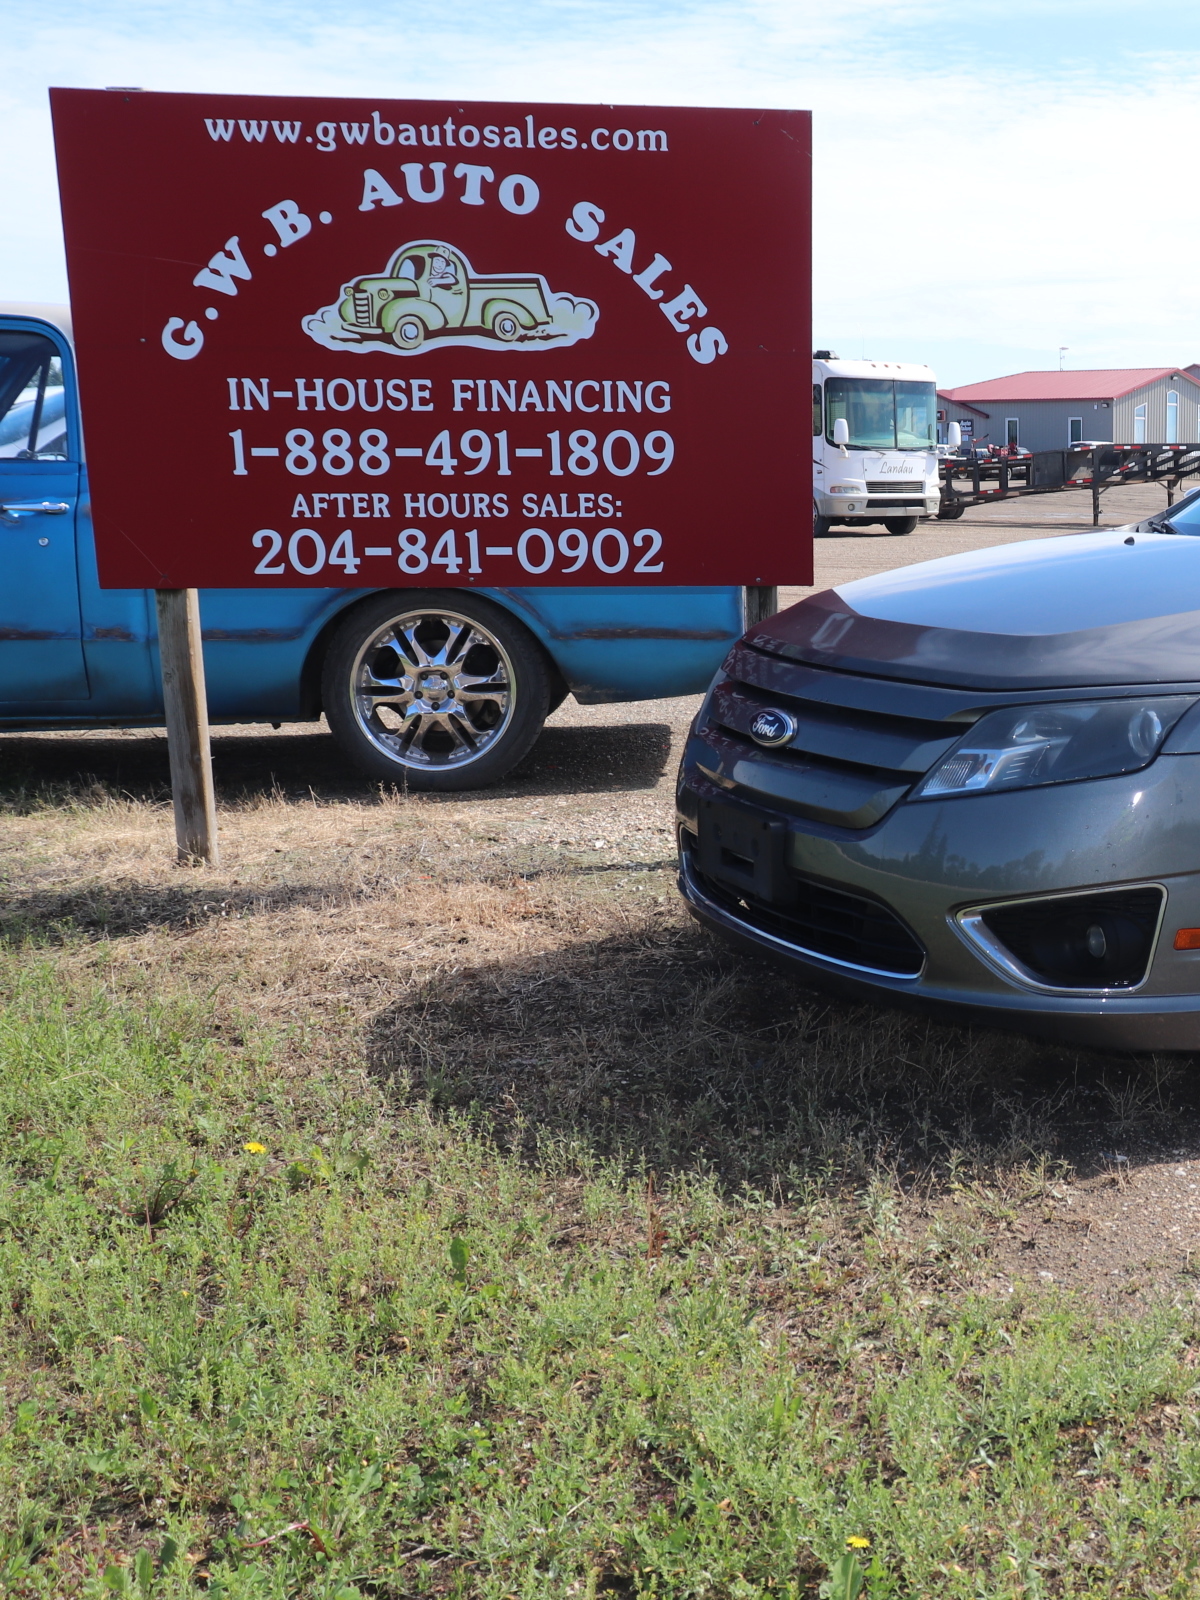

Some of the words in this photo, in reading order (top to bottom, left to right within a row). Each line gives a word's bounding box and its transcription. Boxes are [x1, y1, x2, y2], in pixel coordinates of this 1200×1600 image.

[203, 111, 670, 153] www.gwbautosales.com
[161, 199, 333, 361] G.W.B.
[358, 161, 540, 215] AUTO
[565, 201, 729, 365] SALES
[226, 377, 434, 412] IN-HOUSE
[451, 379, 671, 414] FINANCING
[228, 428, 675, 477] 1-888-491-1809
[879, 459, 914, 474] Landau
[291, 493, 391, 518] AFTER
[403, 492, 509, 519] HOURS
[522, 492, 622, 518] SALES:
[252, 527, 664, 576] 204-841-0902
[752, 713, 779, 738] Ford
